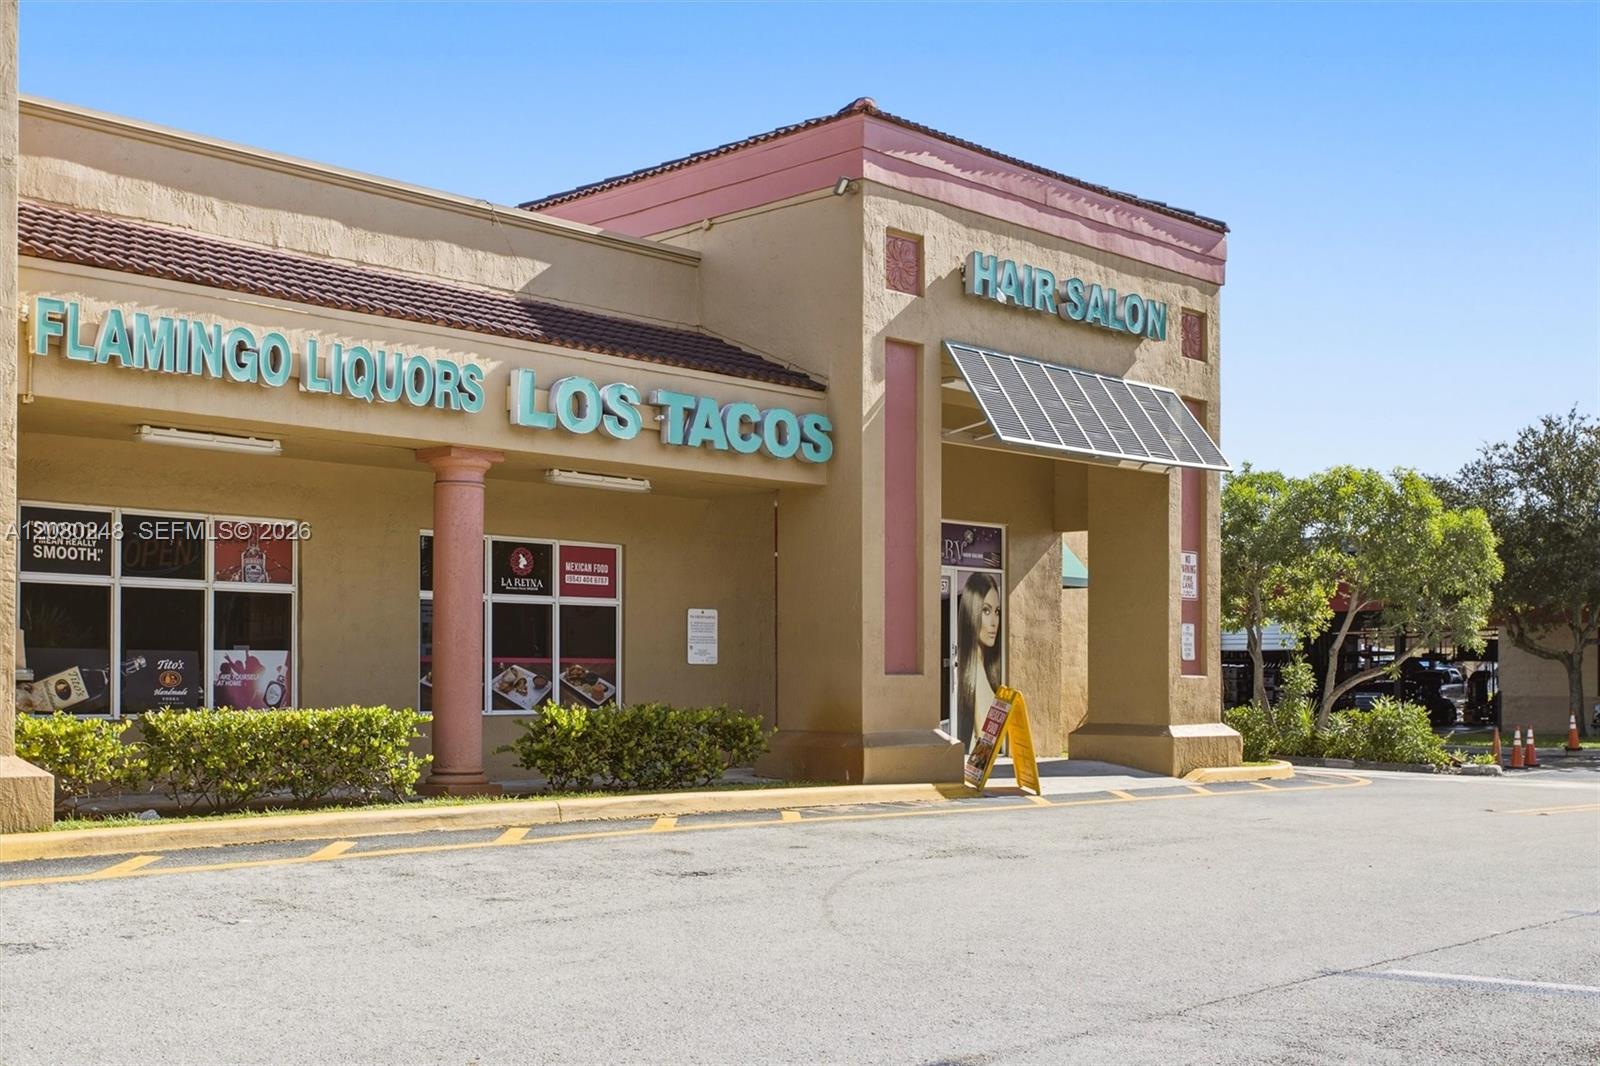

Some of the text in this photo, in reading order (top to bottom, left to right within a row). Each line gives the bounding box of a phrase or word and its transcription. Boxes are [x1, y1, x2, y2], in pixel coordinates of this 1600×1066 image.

[972, 251, 1167, 341] HAIR SALON
[34, 296, 486, 413] FLAMINGO LIQUORS
[514, 368, 833, 463] LOS TACOS
[65, 537, 97, 547] REALLY
[125, 538, 193, 568] OPEN
[565, 562, 609, 574] MEXICAN FOOD
[501, 577, 544, 589] LA REYNA
[157, 659, 184, 670] Tito's
[153, 687, 188, 696] Handmade
